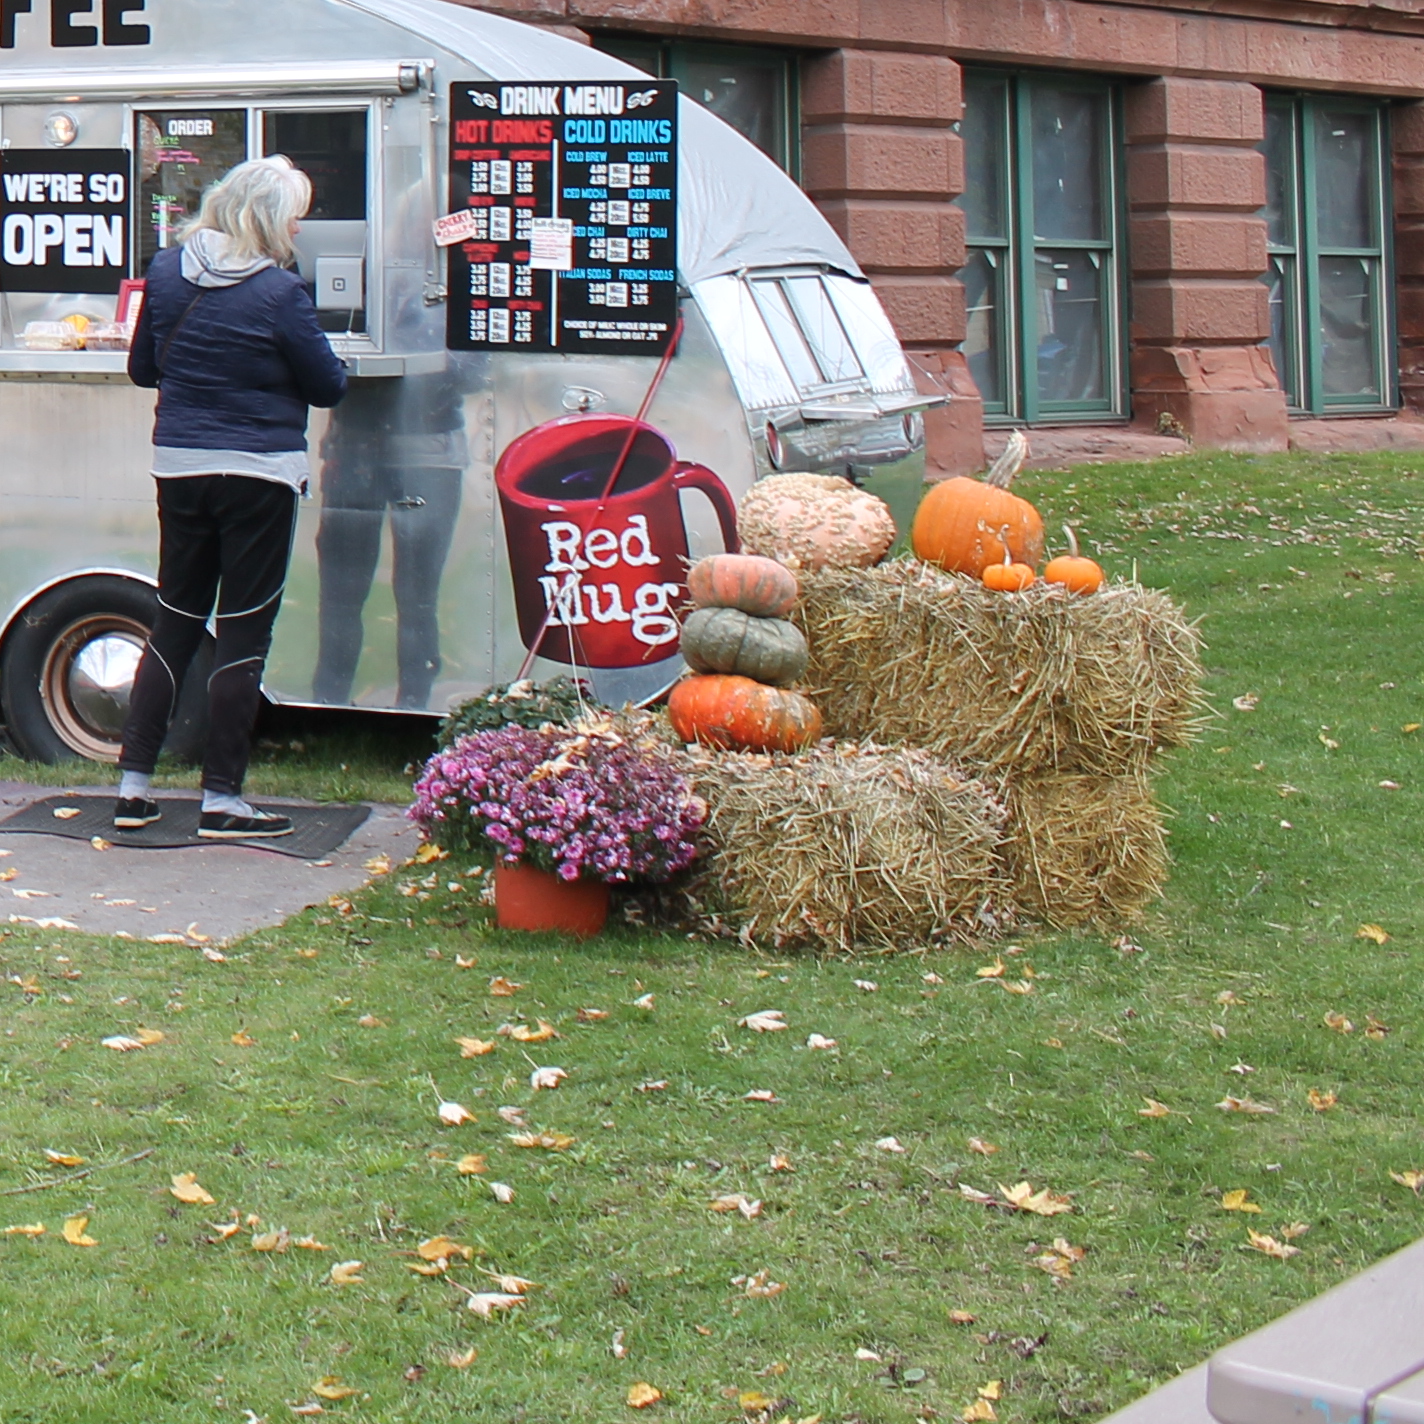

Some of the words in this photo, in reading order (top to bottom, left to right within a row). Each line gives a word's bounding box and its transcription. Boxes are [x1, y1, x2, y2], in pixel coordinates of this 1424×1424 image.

[501, 86, 560, 115] DRINK
[564, 86, 624, 115] MENU
[168, 120, 213, 135] ORDER
[455, 120, 488, 143] HOT
[492, 120, 554, 143] DRINKS
[564, 120, 606, 144] COLD
[610, 120, 671, 144] DRINKS
[566, 151, 584, 162] COLD
[585, 151, 607, 162] BREW
[627, 151, 645, 162] ICED
[646, 152, 669, 162] LATTE
[3, 173, 83, 202] WE'RE
[89, 173, 124, 202] SO
[563, 188, 580, 198] ICED
[581, 188, 608, 198] MOCHA
[628, 189, 645, 199] ICED
[646, 189, 671, 200] BREVE
[572, 226, 586, 237] CED
[587, 226, 605, 237] CHAI
[627, 227, 649, 238] DIRTY
[650, 227, 668, 238] CHAI
[3, 213, 123, 266] OPEN
[587, 268, 612, 279] SODAS
[619, 269, 648, 280] FRENCH
[649, 269, 674, 281] SODAS
[541, 514, 661, 573] Red
[537, 573, 679, 645] Mug
